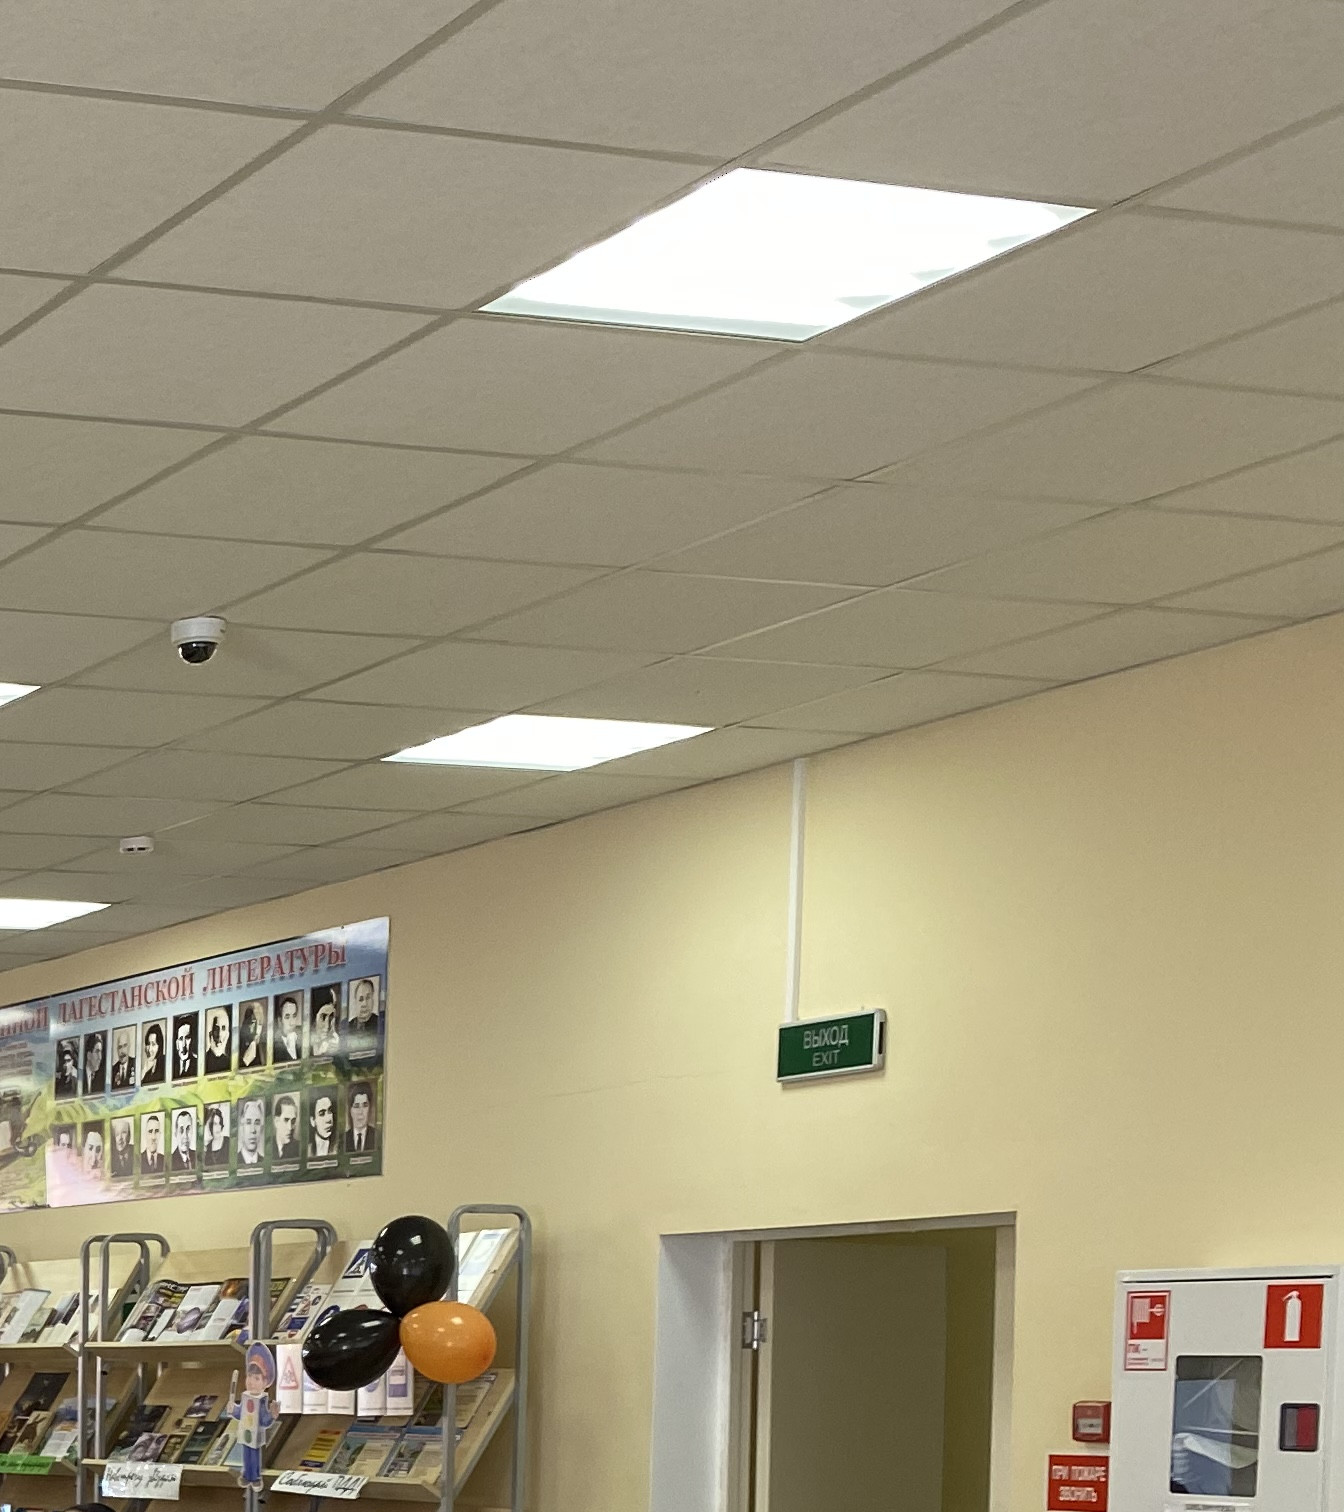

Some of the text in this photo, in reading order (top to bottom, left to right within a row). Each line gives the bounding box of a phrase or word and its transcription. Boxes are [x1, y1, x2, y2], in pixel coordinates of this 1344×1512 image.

[57, 966, 195, 1025] ДАГЕСТАНСКОЙ
[202, 941, 348, 994] ЛИТЕРАТУРЫ
[803, 1025, 849, 1050] ВЫХОД
[812, 1049, 841, 1067] EXIT
